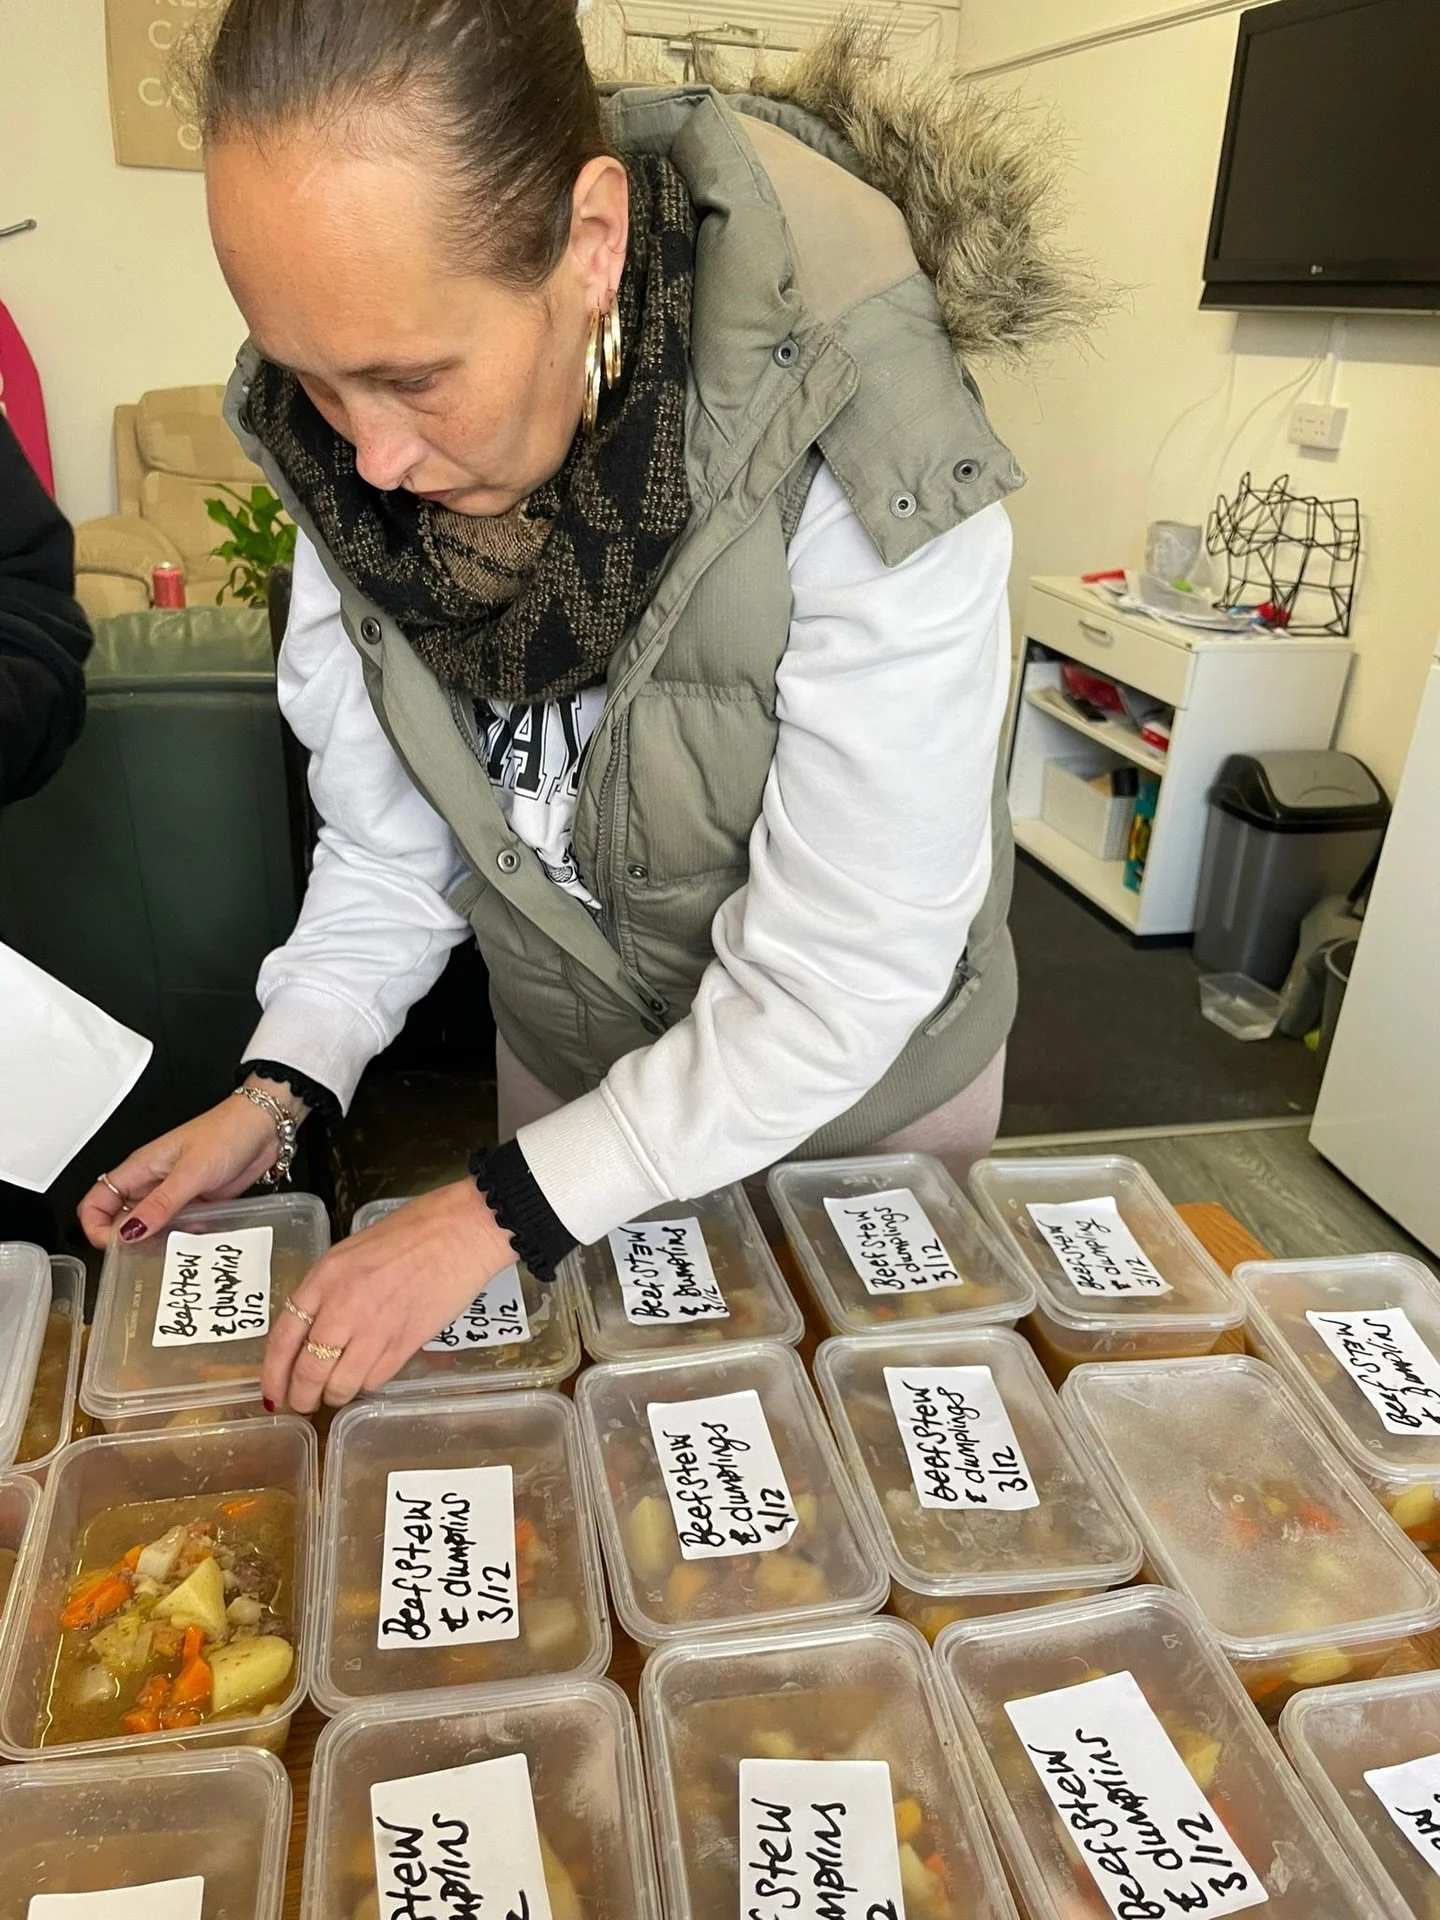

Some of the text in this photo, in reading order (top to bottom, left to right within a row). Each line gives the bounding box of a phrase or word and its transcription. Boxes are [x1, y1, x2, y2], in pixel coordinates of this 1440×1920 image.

[922, 1238, 958, 1282] 3/12
[238, 1291, 265, 1329] 3/12
[491, 1298, 523, 1336] 3/12
[936, 1386, 985, 1484] dumplings
[988, 1445, 1028, 1492] 3/12
[478, 1561, 514, 1624] 3/12
[805, 1802, 859, 1920] mplins
[1177, 1812, 1248, 1897] 3/12
